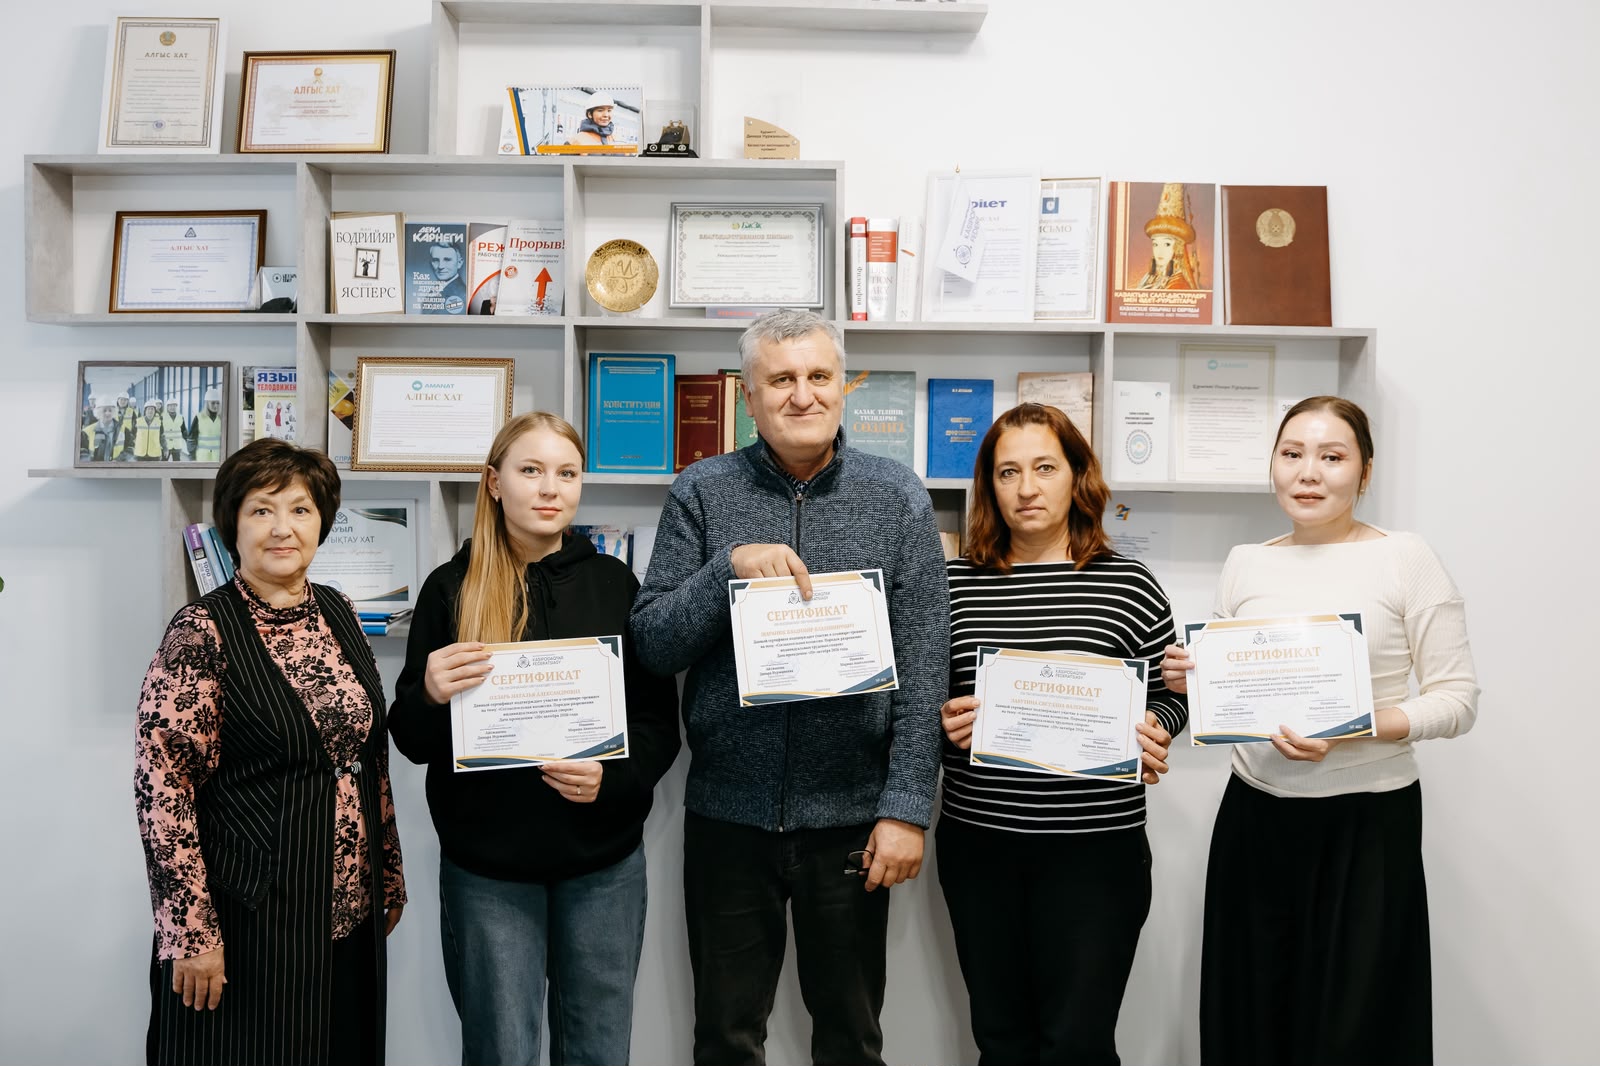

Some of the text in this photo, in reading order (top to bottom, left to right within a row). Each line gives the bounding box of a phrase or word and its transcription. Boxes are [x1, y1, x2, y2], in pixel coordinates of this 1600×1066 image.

[326, 84, 342, 94] ХАТ
[336, 229, 395, 245] БОДРИЙЯР
[413, 233, 464, 243] КАРНЕГИ
[509, 237, 565, 252] Прорыв!
[342, 287, 396, 298] ЯСПЕРС
[603, 400, 660, 408] КОНСТИТУЦИЯ
[853, 422, 904, 433] СӨЗДІГІ
[203, 561, 211, 577] 1000
[767, 605, 848, 621] СЕРТИФИКАТ
[1227, 646, 1320, 662] СЕРТИФИКАТ
[491, 670, 581, 685] СЕРТИФИКАТ
[1014, 680, 1102, 697] СЕРТИФИКАТ
